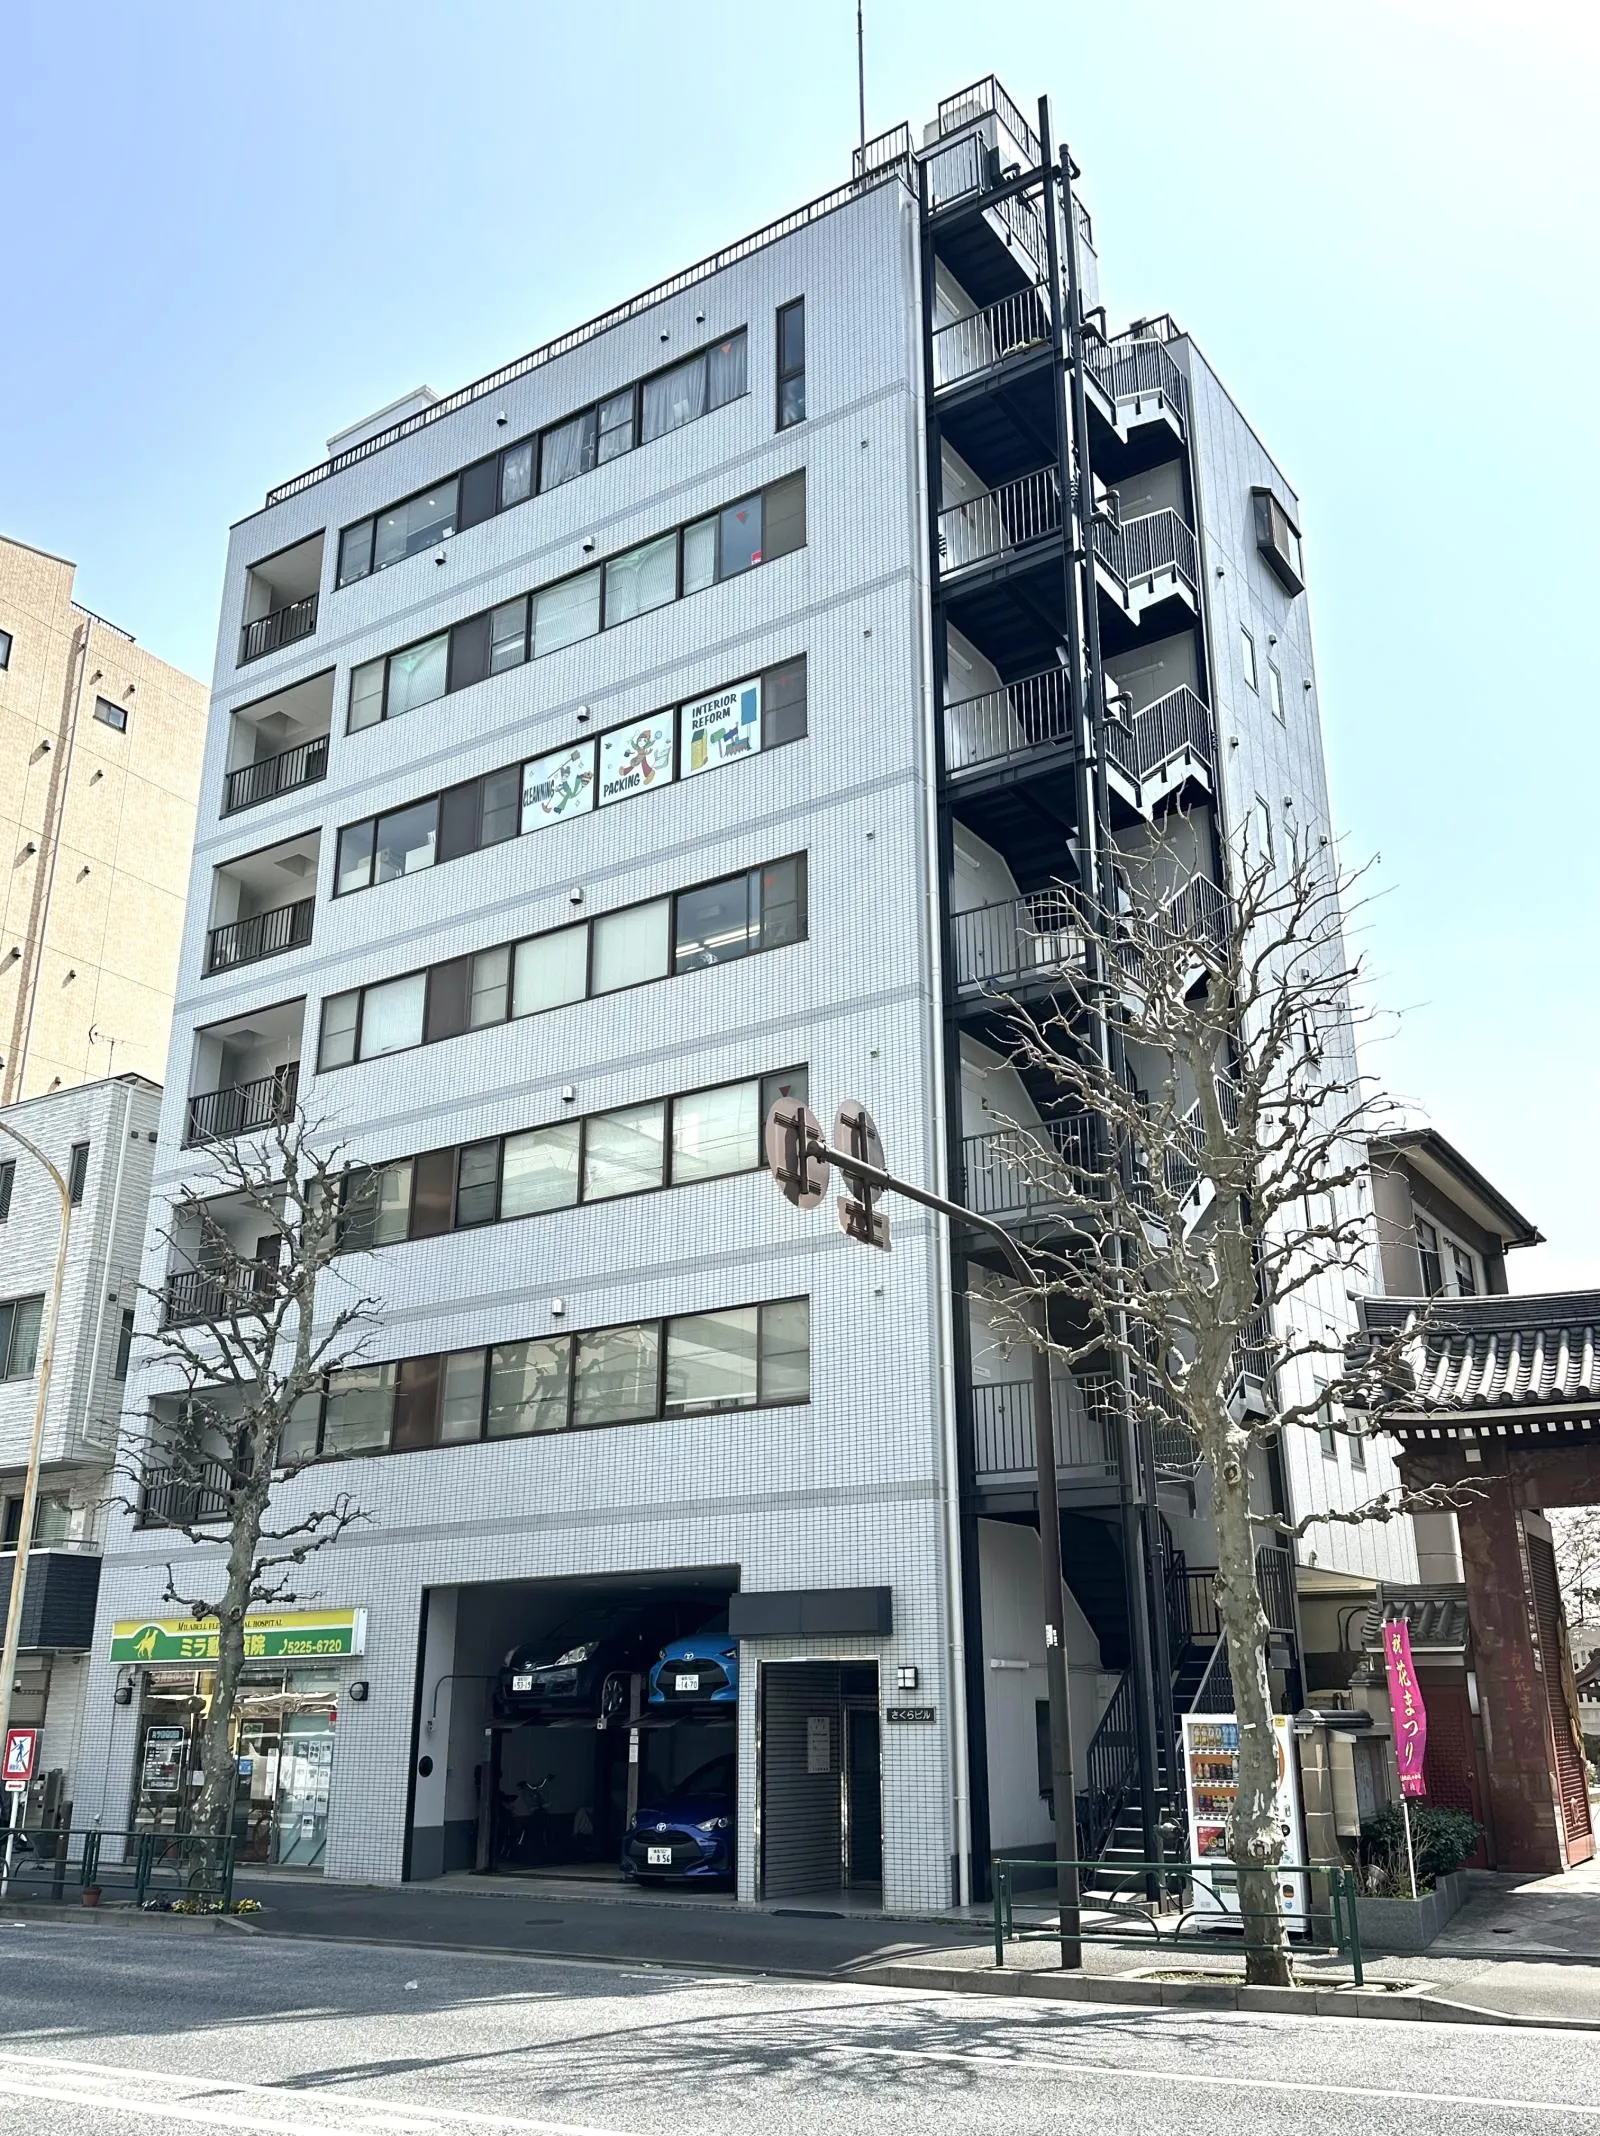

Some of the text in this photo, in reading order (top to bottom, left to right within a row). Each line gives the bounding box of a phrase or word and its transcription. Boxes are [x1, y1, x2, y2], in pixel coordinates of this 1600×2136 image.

[692, 693, 737, 718] INTERIOR
[692, 707, 731, 730] REFORM
[523, 780, 555, 807] CLEANNING
[603, 773, 640, 797] PACKING
[253, 1619, 283, 1628] HOSPITAL
[287, 1638, 342, 1655] 5225-6720
[891, 1710, 931, 1720] さくらビル
